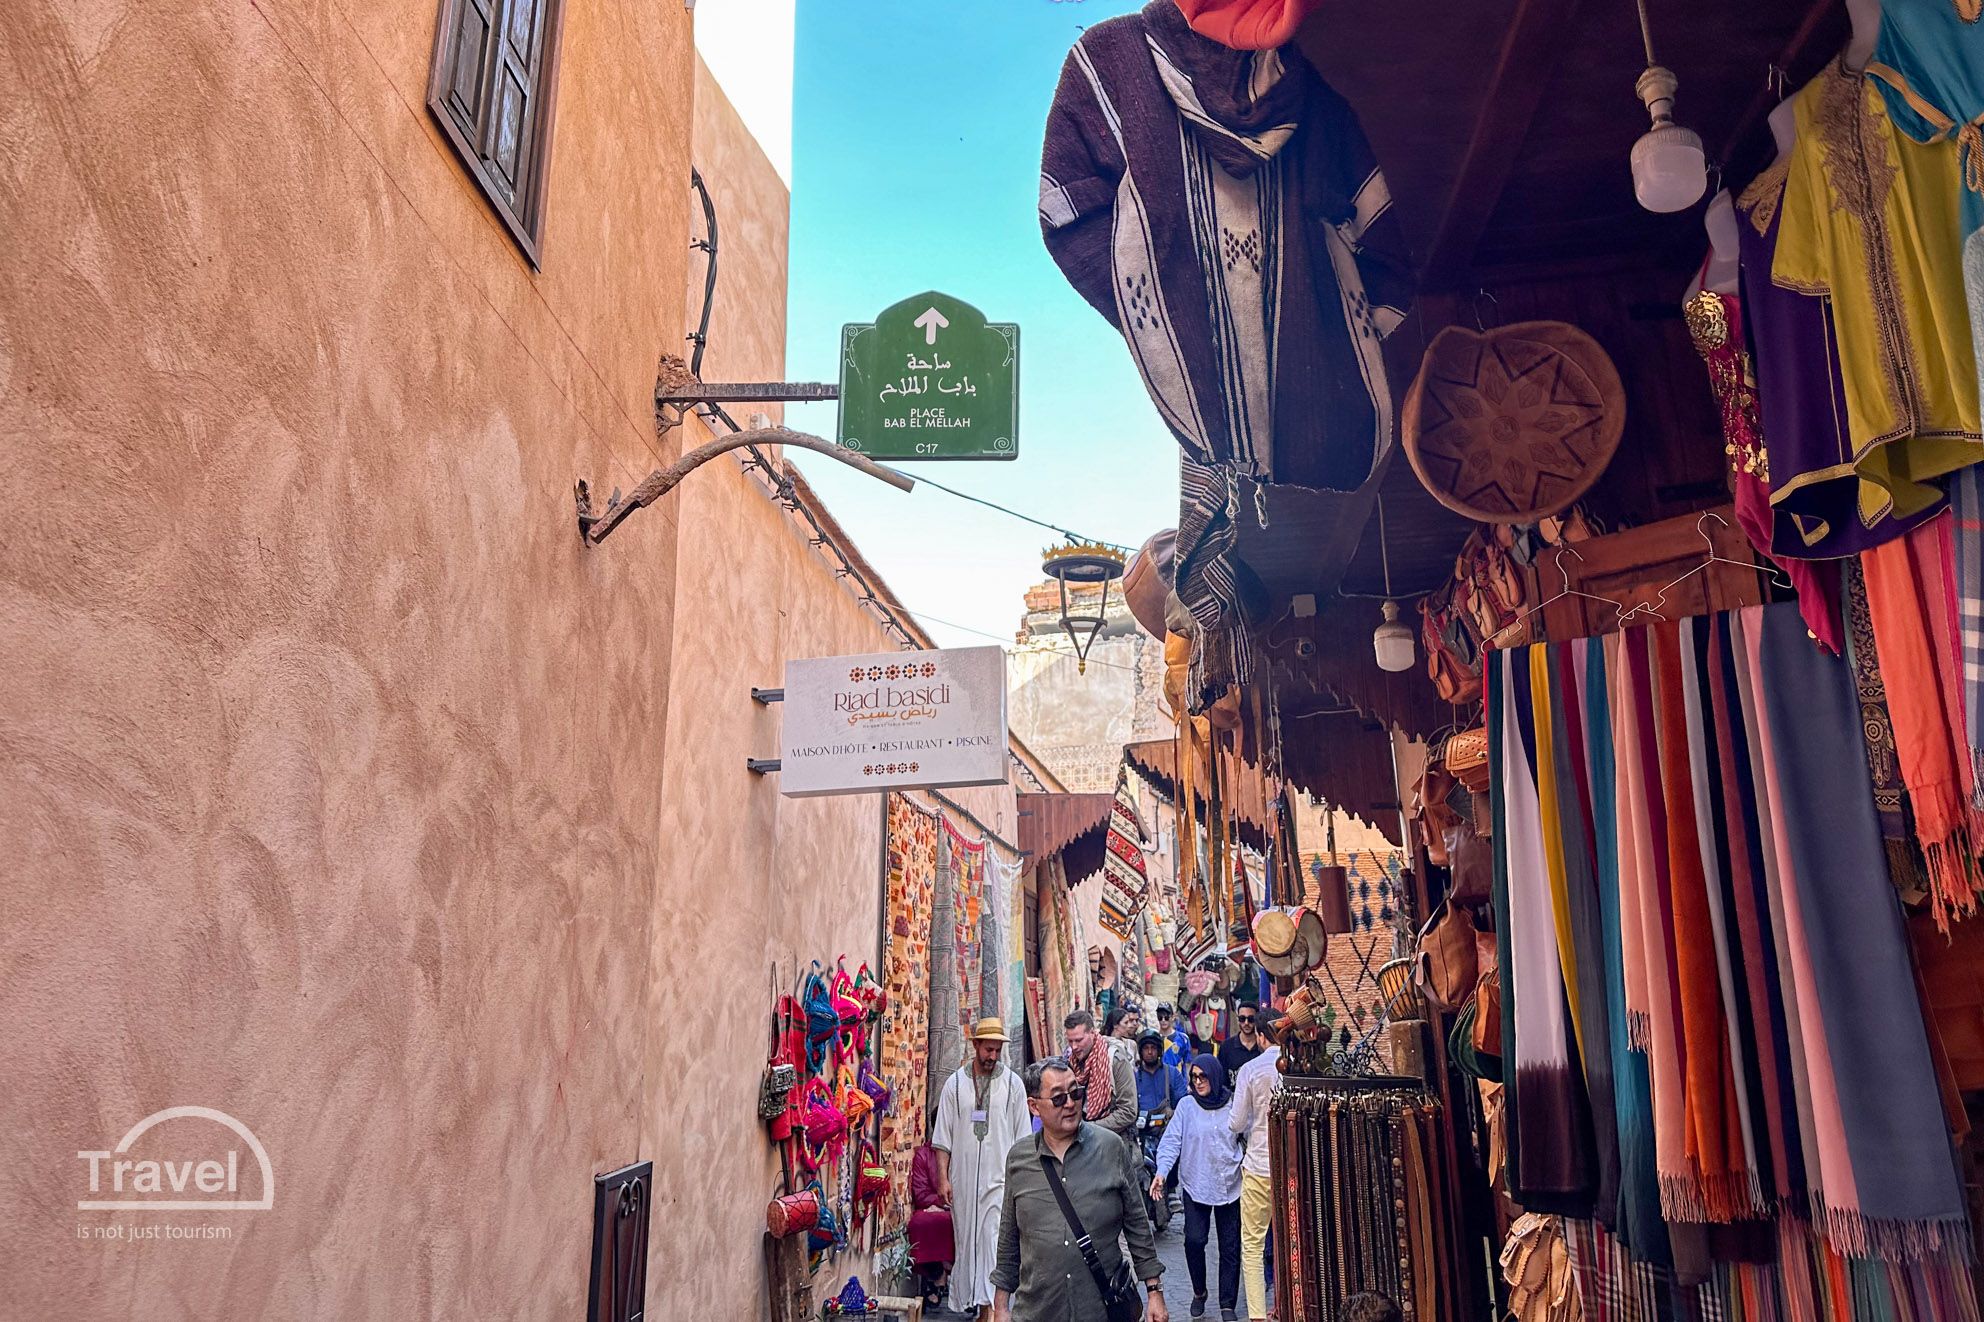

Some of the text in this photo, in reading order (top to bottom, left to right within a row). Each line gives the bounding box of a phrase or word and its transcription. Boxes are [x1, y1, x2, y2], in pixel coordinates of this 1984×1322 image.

[907, 352, 951, 371] ساحة
[879, 375, 977, 403] باب الملاح
[910, 407, 945, 418] PLACE
[884, 418, 971, 428] BAB EL MELLAH
[915, 443, 939, 454] C17
[834, 683, 950, 712] Riad basidi
[900, 706, 937, 721] رياض
[791, 745, 831, 758] MAISON
[879, 738, 944, 752] RESTAURANT
[956, 734, 993, 748] PISCINE
